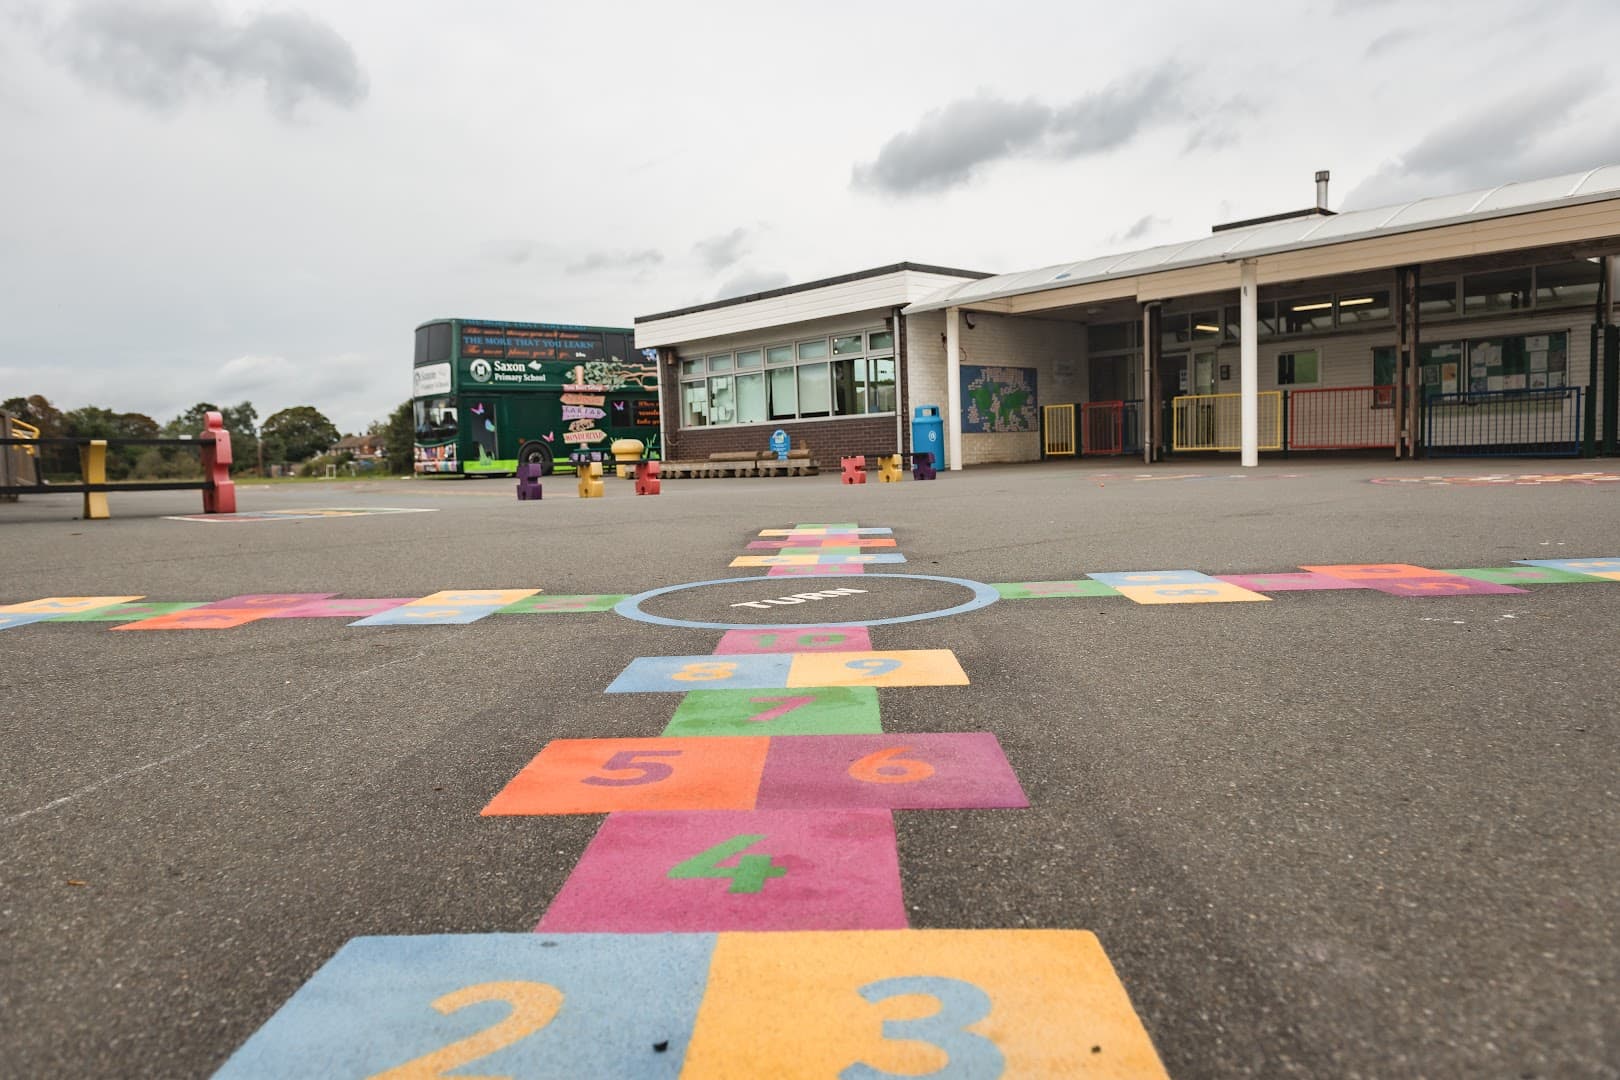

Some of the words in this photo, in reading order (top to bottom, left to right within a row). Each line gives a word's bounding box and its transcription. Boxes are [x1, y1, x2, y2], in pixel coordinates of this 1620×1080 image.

[464, 336, 483, 345] THE
[485, 337, 512, 346] MORE
[515, 338, 540, 347] THAT
[543, 339, 561, 348] YOU
[564, 341, 594, 349] LEARN
[494, 360, 526, 372] Saxon
[495, 373, 522, 383] Primary
[523, 373, 546, 382] School
[565, 431, 602, 442] WONDERLAND
[729, 587, 869, 609] TURN
[751, 632, 847, 648] 10
[670, 660, 740, 683] 8
[847, 657, 904, 678] 9
[747, 695, 818, 723] 7
[580, 749, 684, 787] 5
[847, 747, 936, 784] 6
[667, 833, 789, 895] 4
[364, 980, 567, 1080] 2
[836, 974, 1006, 1080] 3
